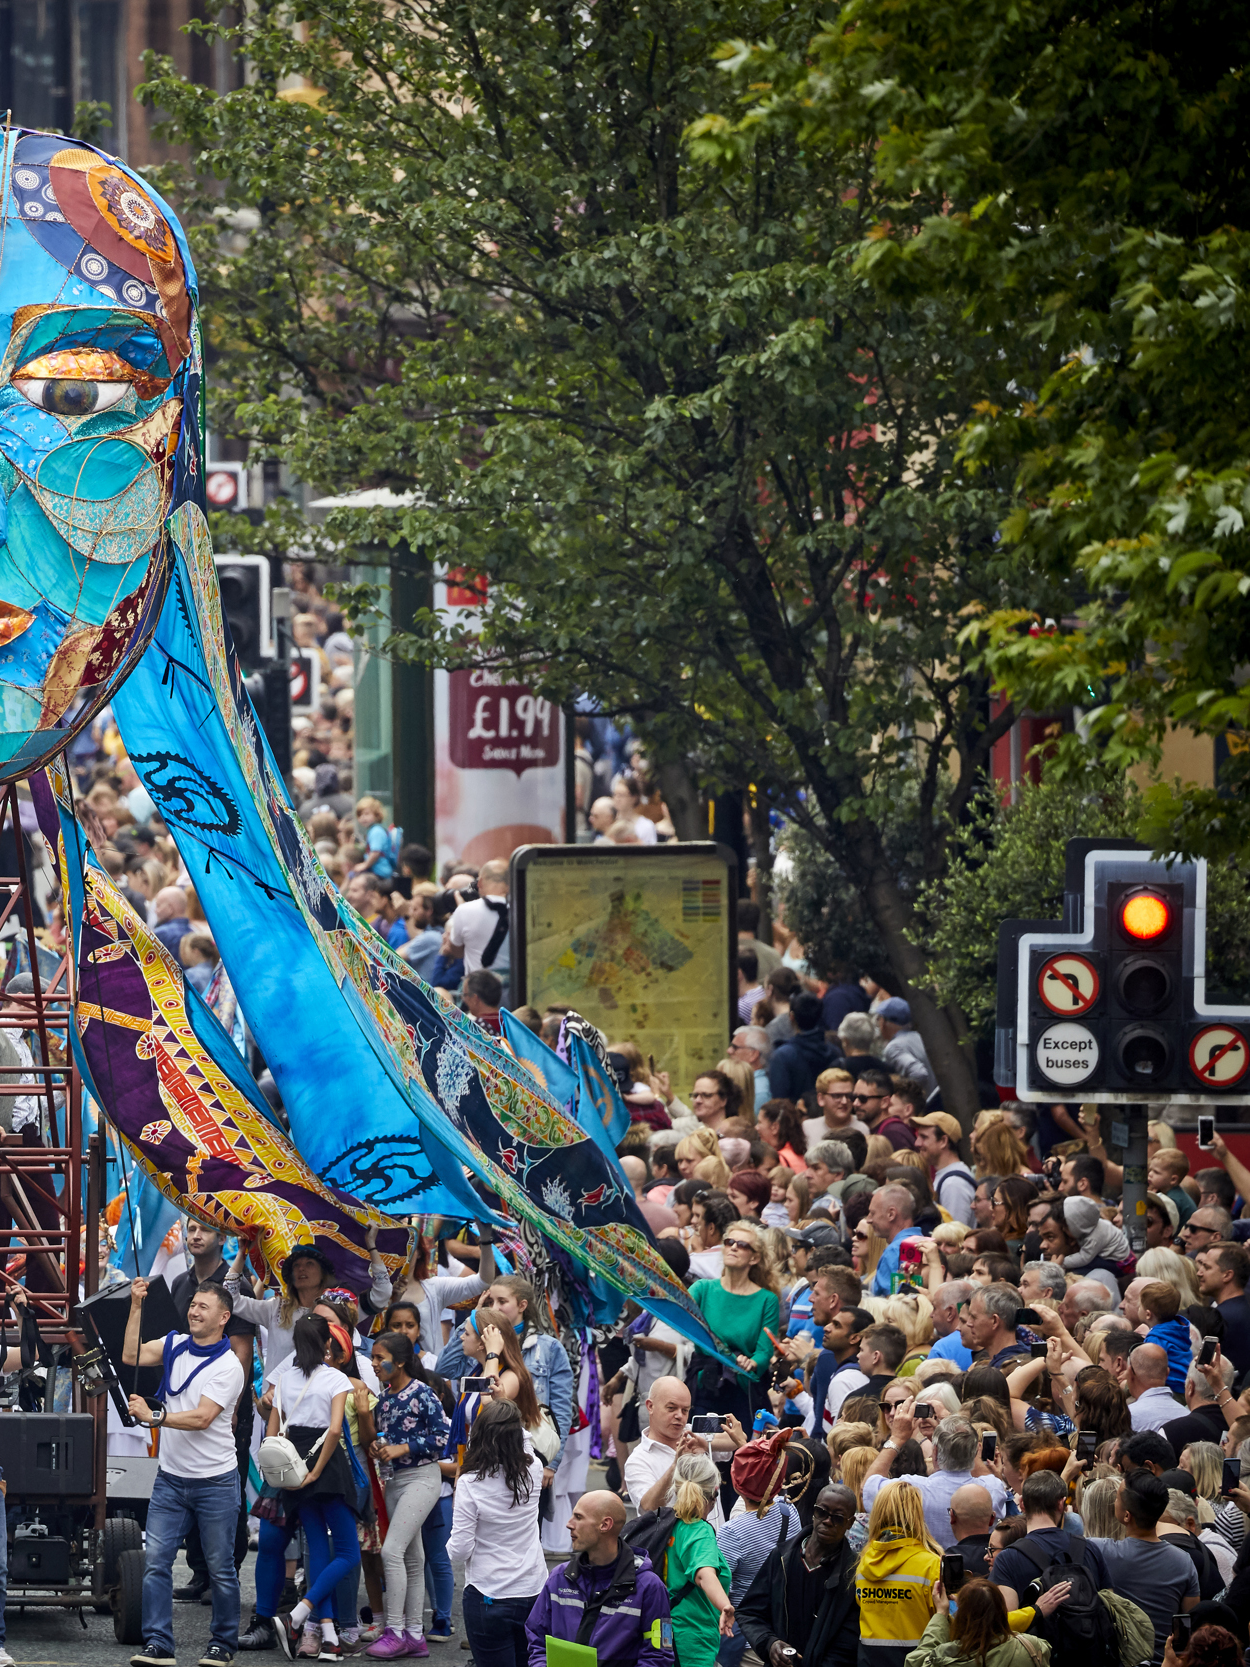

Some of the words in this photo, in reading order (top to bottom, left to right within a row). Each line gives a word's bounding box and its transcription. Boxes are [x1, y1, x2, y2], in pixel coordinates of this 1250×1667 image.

[467, 694, 552, 739] £1.99
[1043, 1037, 1093, 1053] Except
[1046, 1056, 1089, 1069] buses
[861, 1587, 912, 1600] SHOWSEC
